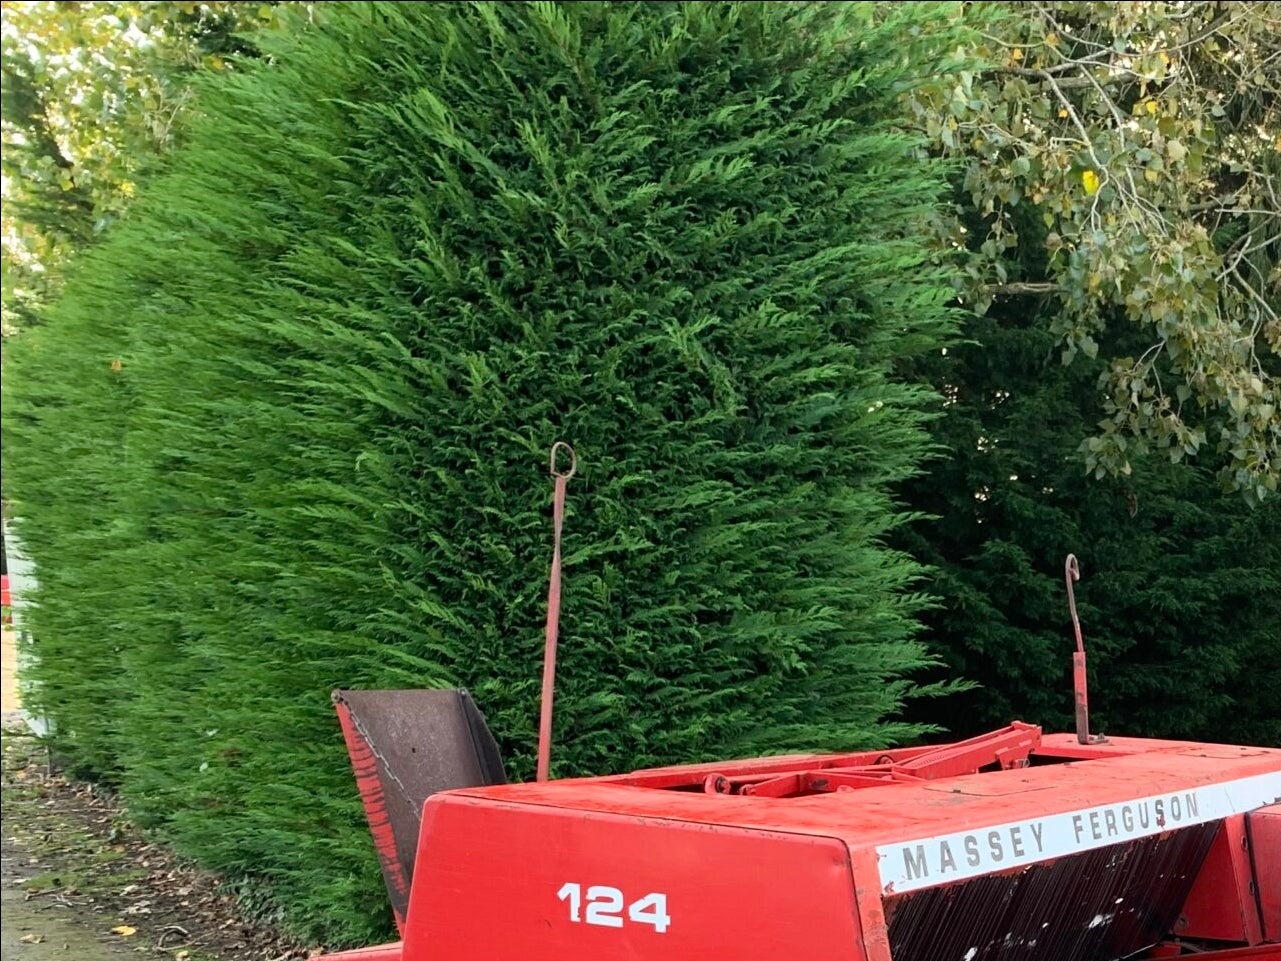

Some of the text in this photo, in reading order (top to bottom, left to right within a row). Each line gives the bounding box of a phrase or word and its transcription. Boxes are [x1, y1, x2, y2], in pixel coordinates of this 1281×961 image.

[902, 822, 1044, 881] MASSEY
[1072, 793, 1200, 844] FERGUSON
[557, 882, 671, 933] 124
